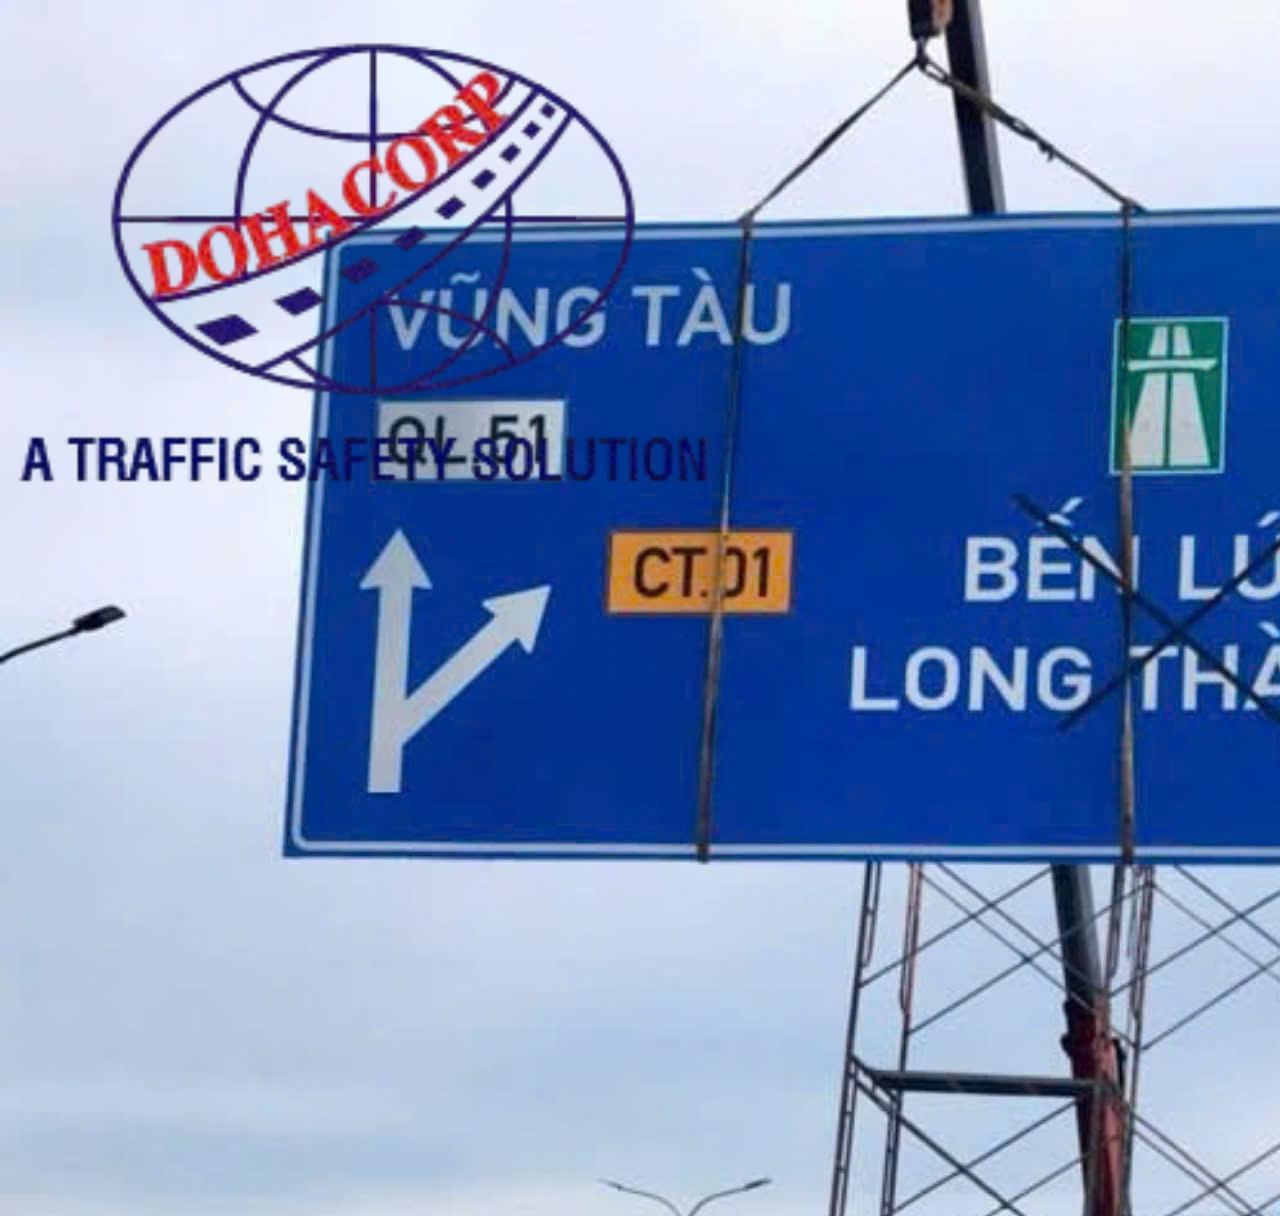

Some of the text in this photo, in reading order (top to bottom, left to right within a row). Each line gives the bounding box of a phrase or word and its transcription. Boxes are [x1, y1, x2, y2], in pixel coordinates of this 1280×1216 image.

[388, 267, 793, 350] VŨNG TÀU
[634, 547, 770, 598] CT.01
[964, 496, 1141, 602] BẾN
[850, 645, 1093, 712] LONG
